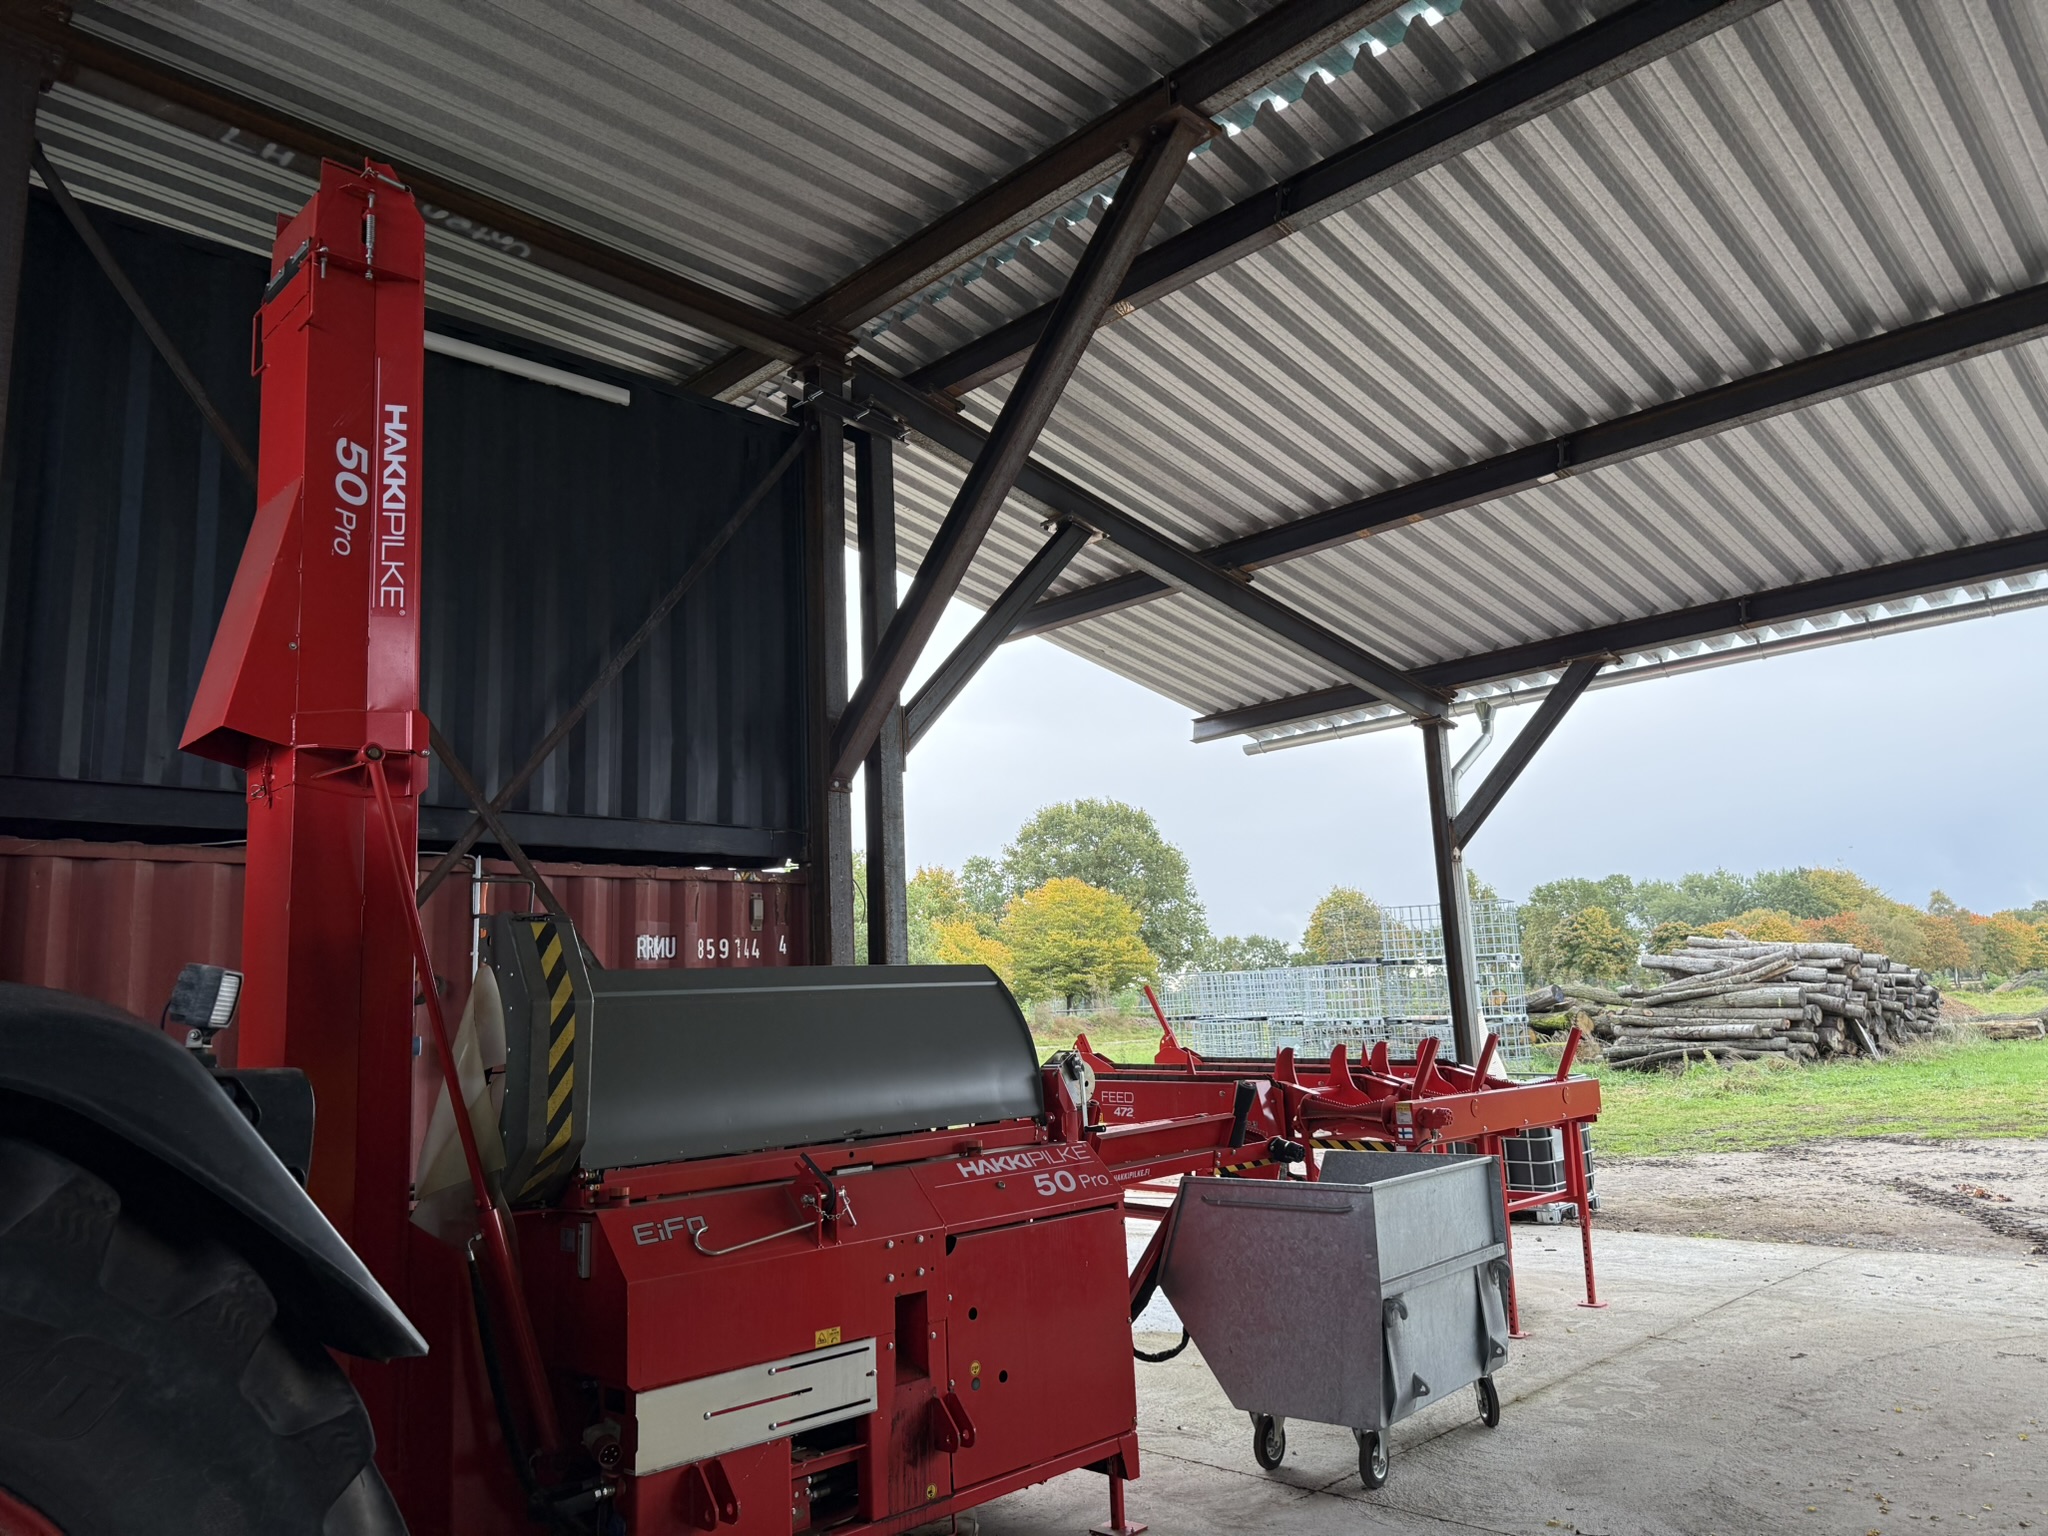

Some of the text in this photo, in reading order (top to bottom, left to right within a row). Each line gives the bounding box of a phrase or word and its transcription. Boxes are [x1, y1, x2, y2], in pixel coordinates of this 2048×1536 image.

[334, 437, 368, 556] 50 Pro
[379, 404, 408, 608] HAKKIPILKE
[779, 935, 787, 954] 4
[1101, 1091, 1134, 1103] FEED
[1113, 1107, 1134, 1117] 472
[956, 1145, 1091, 1177] HAKKIPILKE
[1033, 1170, 1109, 1196] 50 Pro
